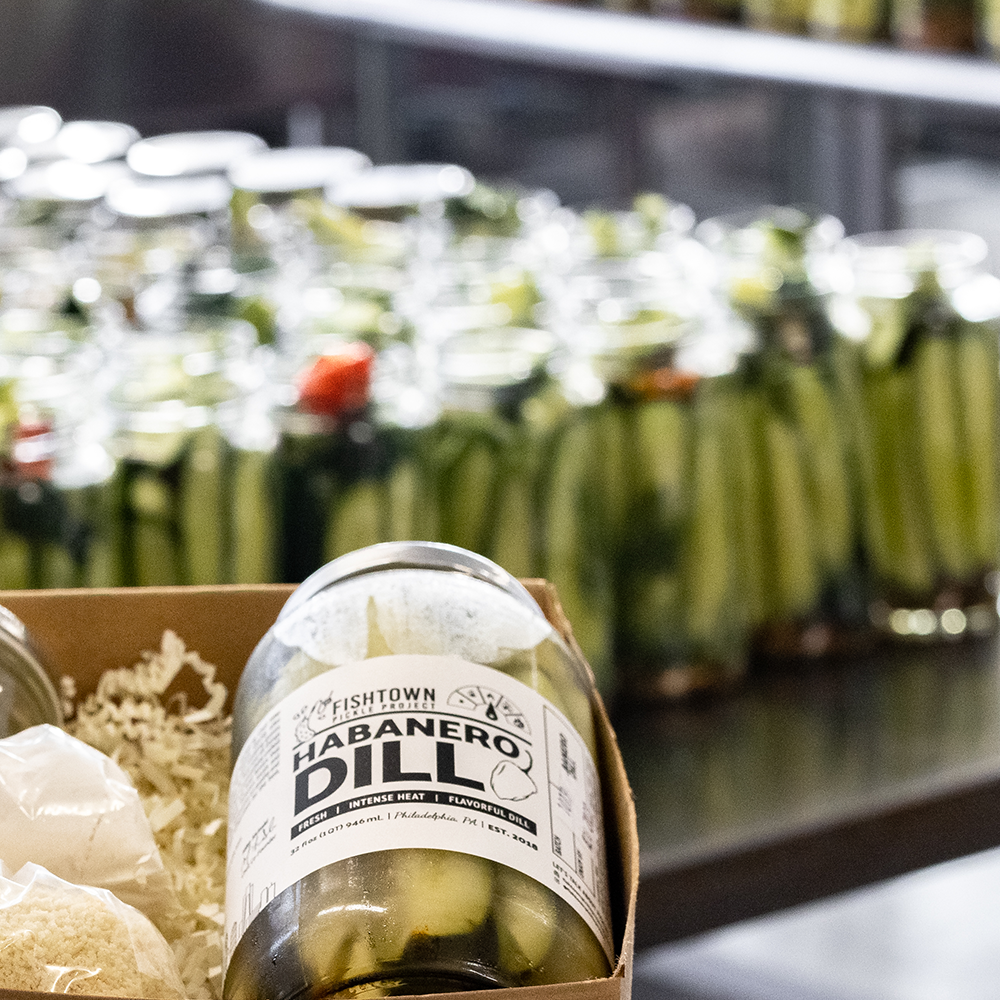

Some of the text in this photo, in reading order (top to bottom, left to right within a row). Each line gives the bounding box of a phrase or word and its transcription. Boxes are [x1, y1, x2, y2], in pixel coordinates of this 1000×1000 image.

[332, 702, 436, 723] PICKLE PROJECT
[333, 688, 435, 715] FISHTOWN
[293, 718, 519, 772] HABANERO
[294, 740, 485, 816] DILL
[298, 792, 530, 832] FRESH INTENSE HEAT FLAVORFUL DILL
[346, 819, 365, 828] 946
[462, 816, 478, 826] PA
[488, 824, 510, 838] EST.
[512, 833, 538, 852] 2018
